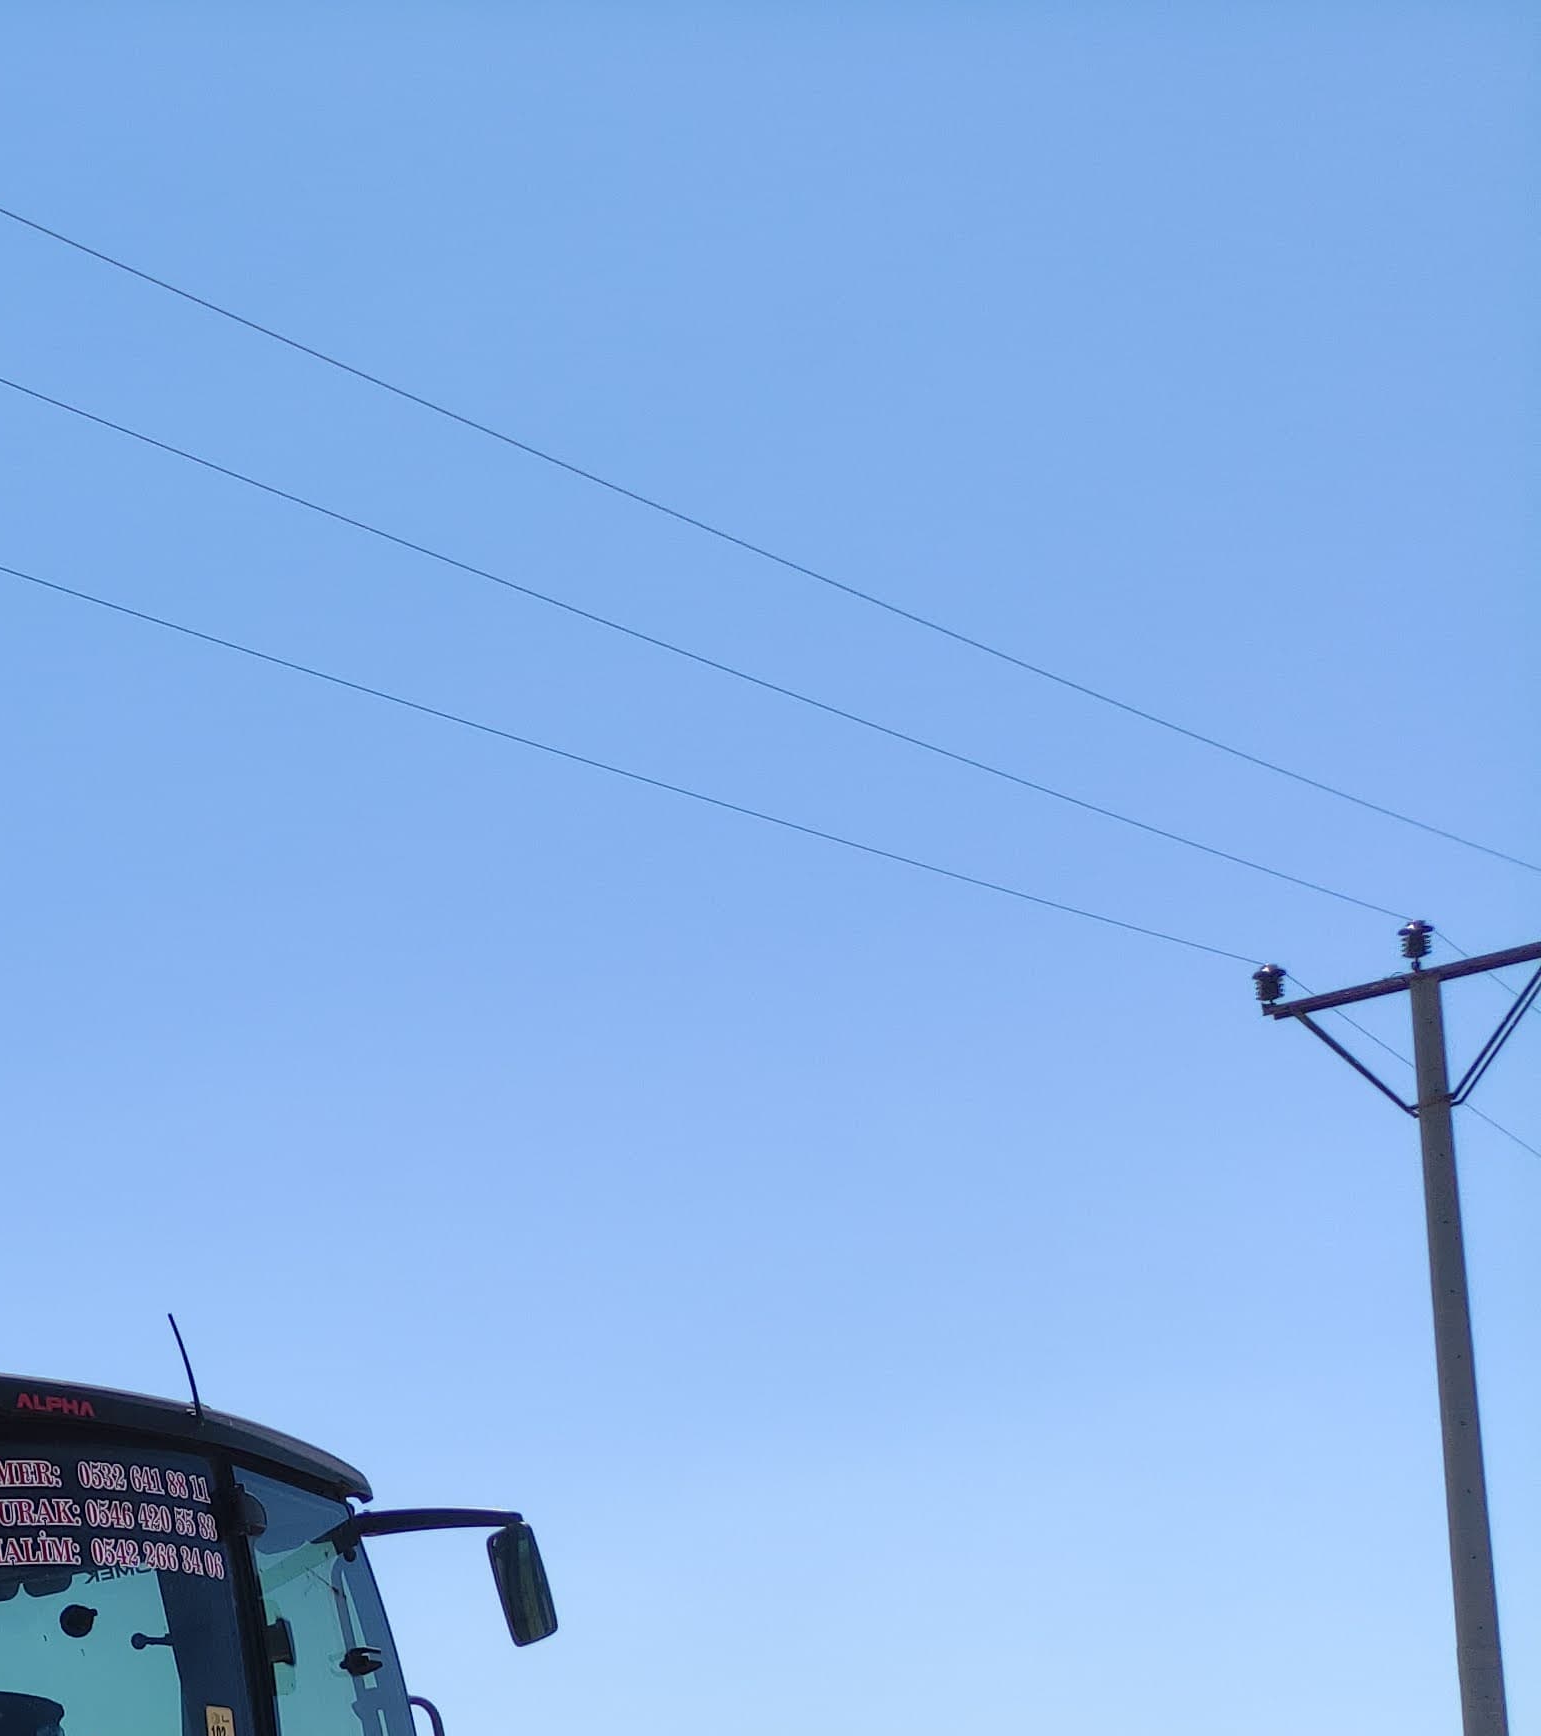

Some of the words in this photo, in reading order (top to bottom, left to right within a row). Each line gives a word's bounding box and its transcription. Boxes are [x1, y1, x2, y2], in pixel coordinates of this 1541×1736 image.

[17, 1393, 95, 1417] ALPHA
[77, 1461, 128, 1491] 0532
[130, 1465, 165, 1495] 641
[166, 1470, 188, 1499] 88
[189, 1475, 211, 1504] 11
[85, 1499, 135, 1529] 0546
[138, 1503, 172, 1533] 420
[174, 1507, 196, 1537] 55
[91, 1538, 140, 1567] 0542
[143, 1541, 178, 1571] 266
[180, 1546, 204, 1576] 34
